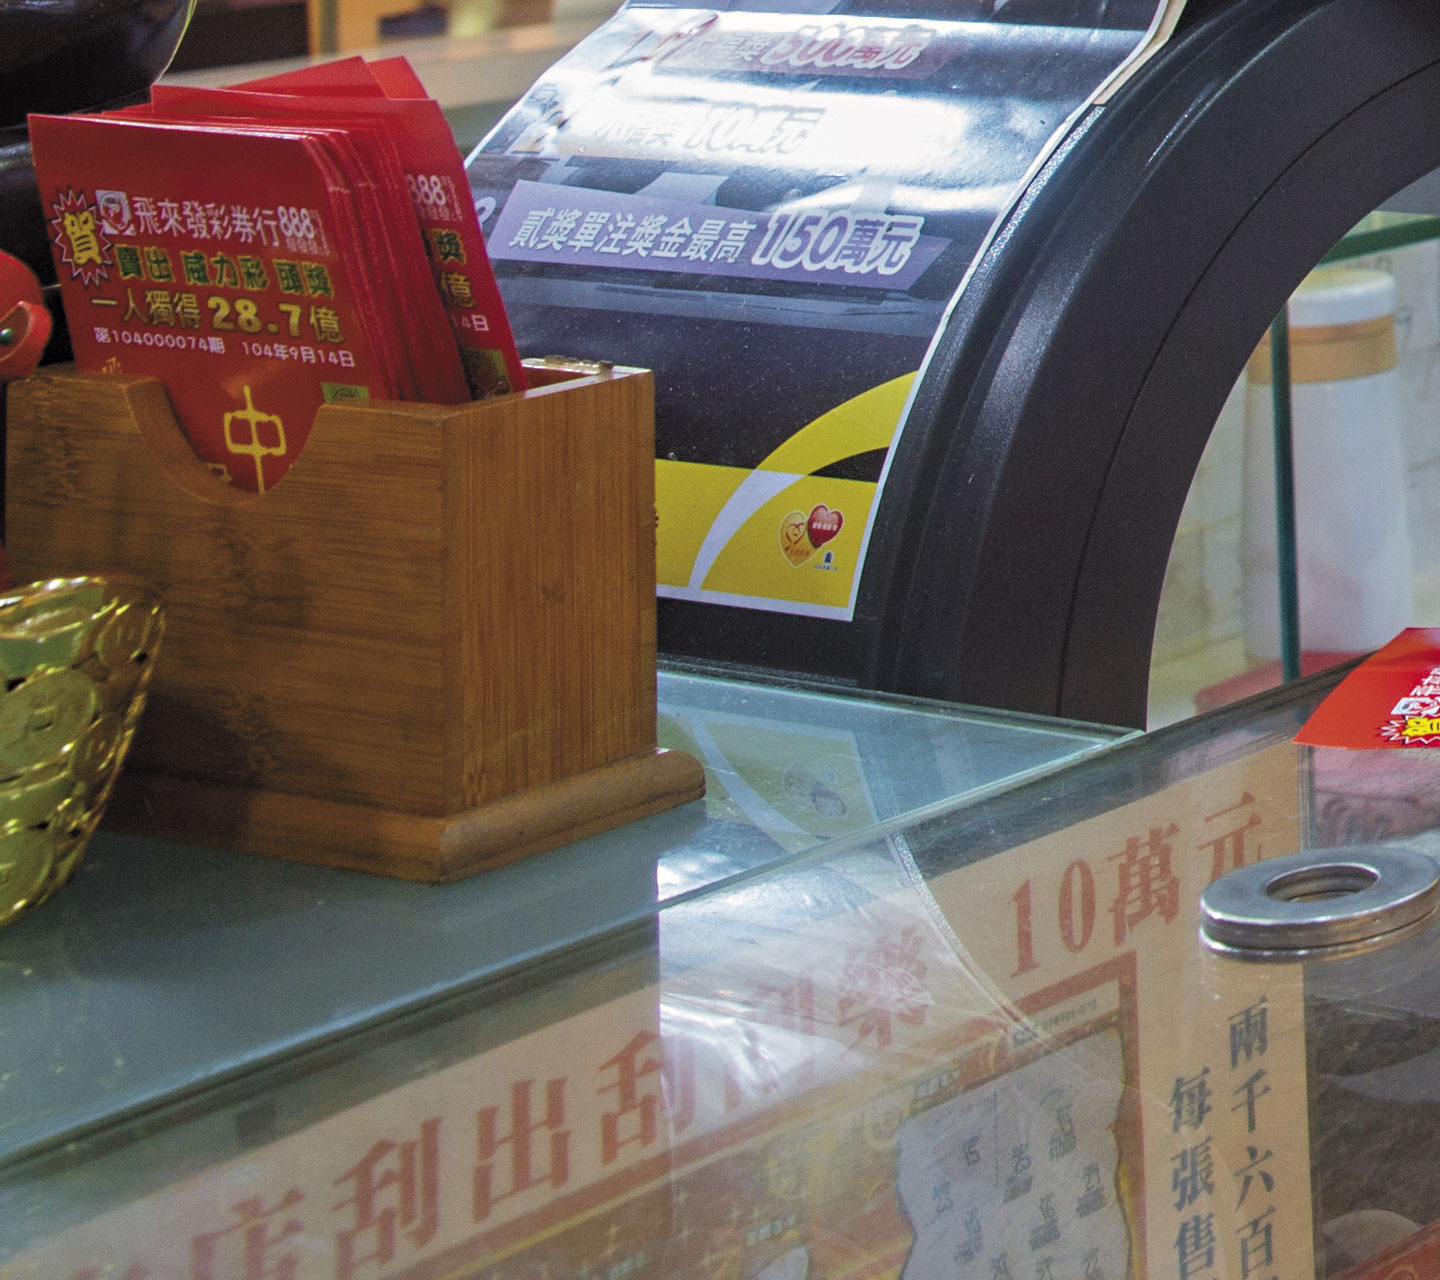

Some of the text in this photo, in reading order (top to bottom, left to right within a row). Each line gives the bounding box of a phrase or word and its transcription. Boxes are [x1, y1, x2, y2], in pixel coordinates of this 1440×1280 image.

[63, 209, 104, 267] 賀
[508, 206, 927, 276] 貳獎單注獎金最高 150萬元
[114, 243, 336, 300] 賣出 威力彩 頭獎
[93, 326, 356, 369] 第104000074期 104年9月14日
[222, 385, 287, 494] 中
